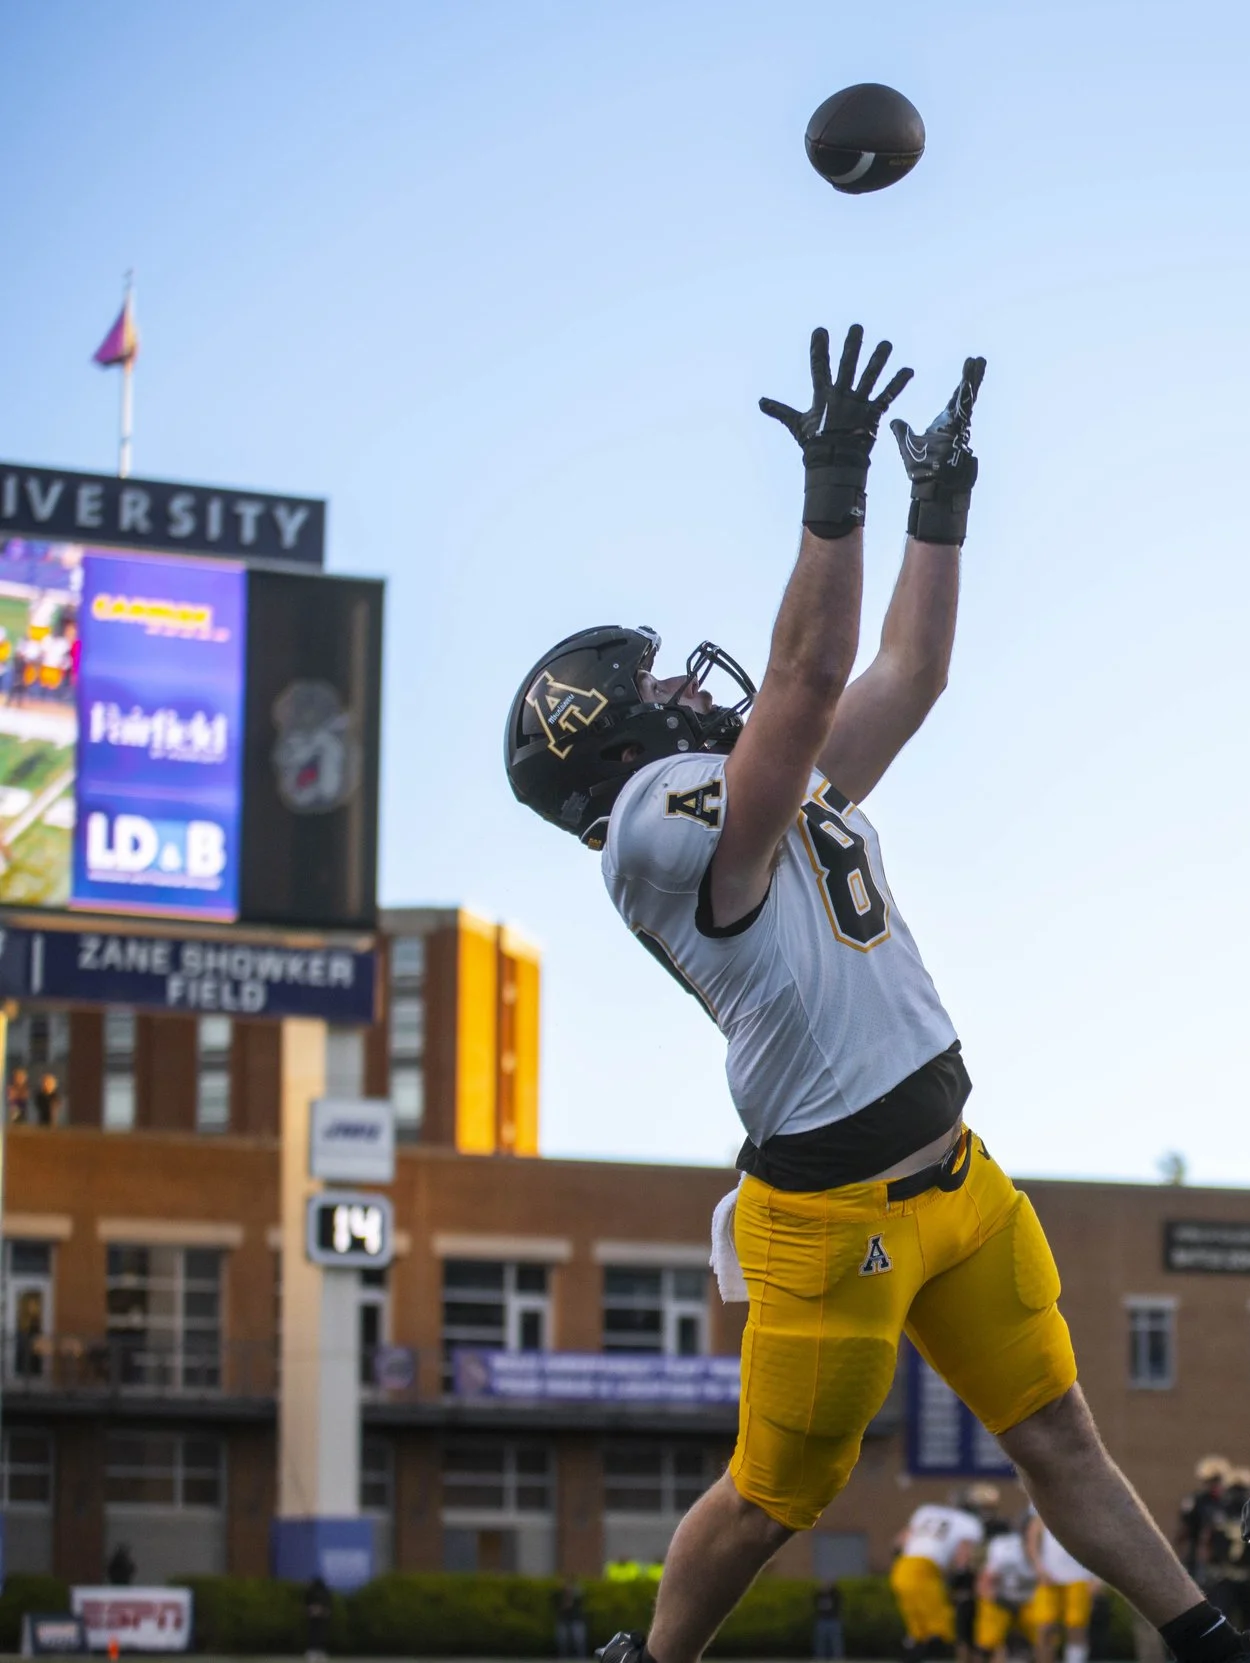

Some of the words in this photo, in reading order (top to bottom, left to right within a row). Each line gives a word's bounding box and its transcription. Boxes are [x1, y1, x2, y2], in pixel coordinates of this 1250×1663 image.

[3, 472, 311, 549] IVERSITY
[664, 777, 724, 830] A
[797, 778, 893, 954] 8
[77, 934, 172, 976] ZANE
[178, 941, 356, 988] SHOWKER
[165, 972, 267, 1012] FIELD
[332, 1204, 382, 1255] 14
[858, 1233, 893, 1277] A
